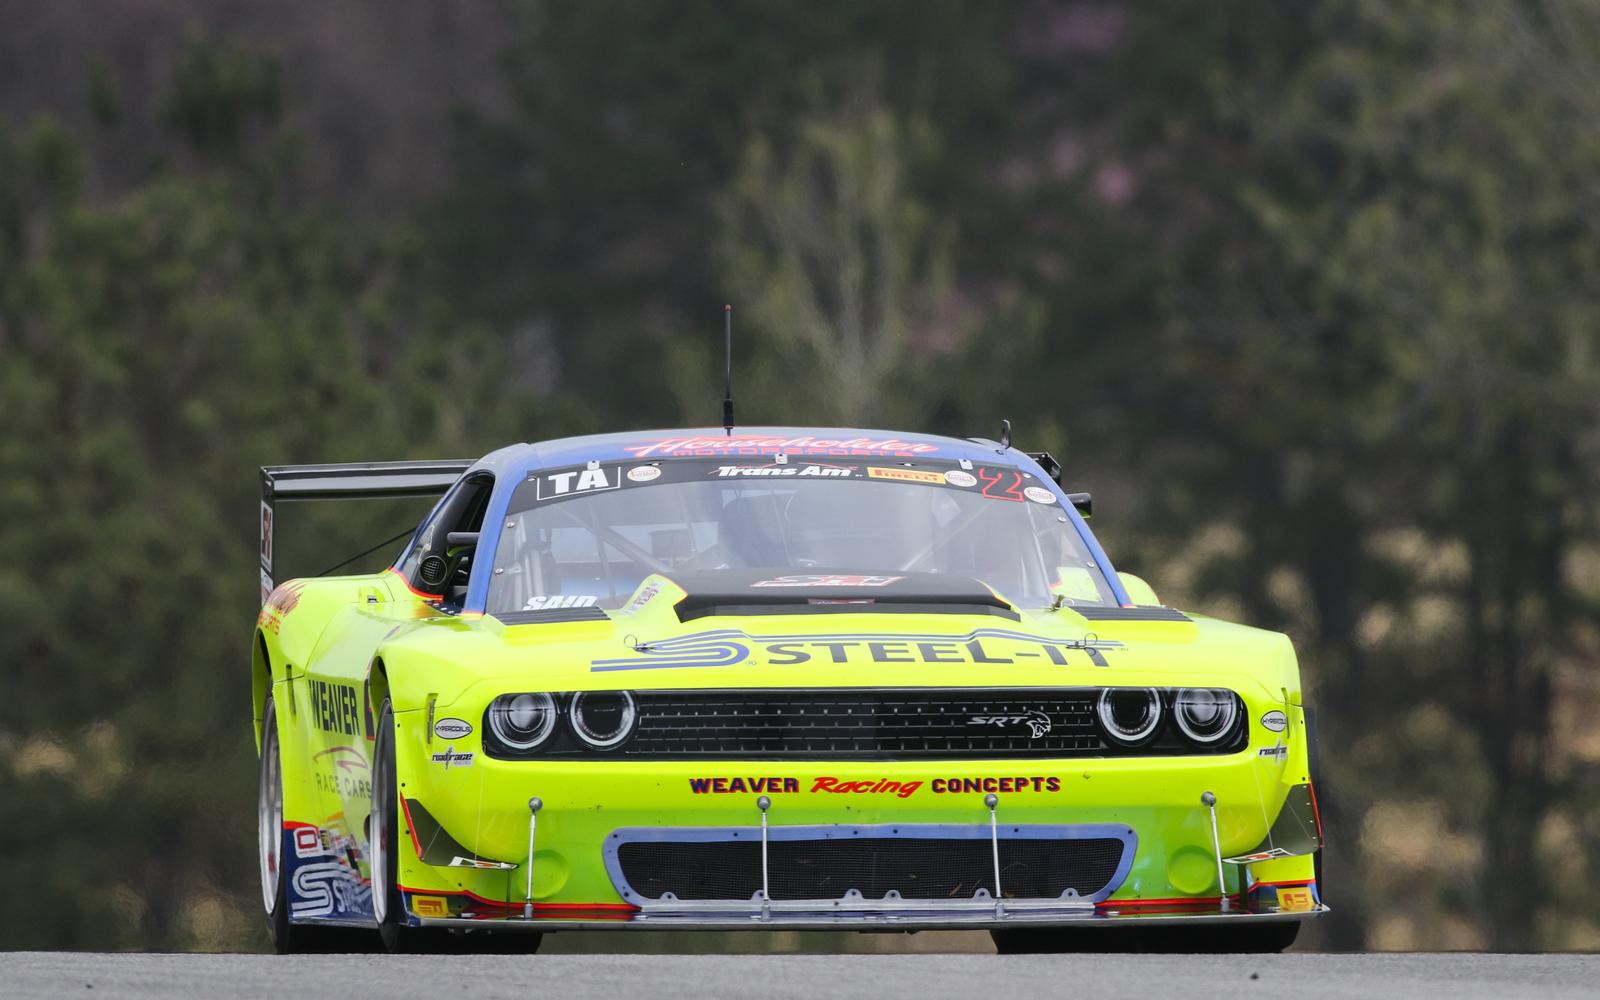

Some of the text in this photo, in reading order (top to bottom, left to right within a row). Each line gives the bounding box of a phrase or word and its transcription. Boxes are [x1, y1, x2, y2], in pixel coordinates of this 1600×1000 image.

[547, 468, 609, 494] TA
[718, 466, 798, 477] Trans
[799, 466, 852, 477] Am
[874, 469, 939, 481] PIRELLI
[765, 640, 1111, 668] STEEL-IT
[308, 679, 361, 737] WEAVER
[967, 715, 1029, 728] SRT
[315, 772, 373, 800] RACE CARS
[689, 776, 1062, 799] WEAVER Racing CONCEPTS
